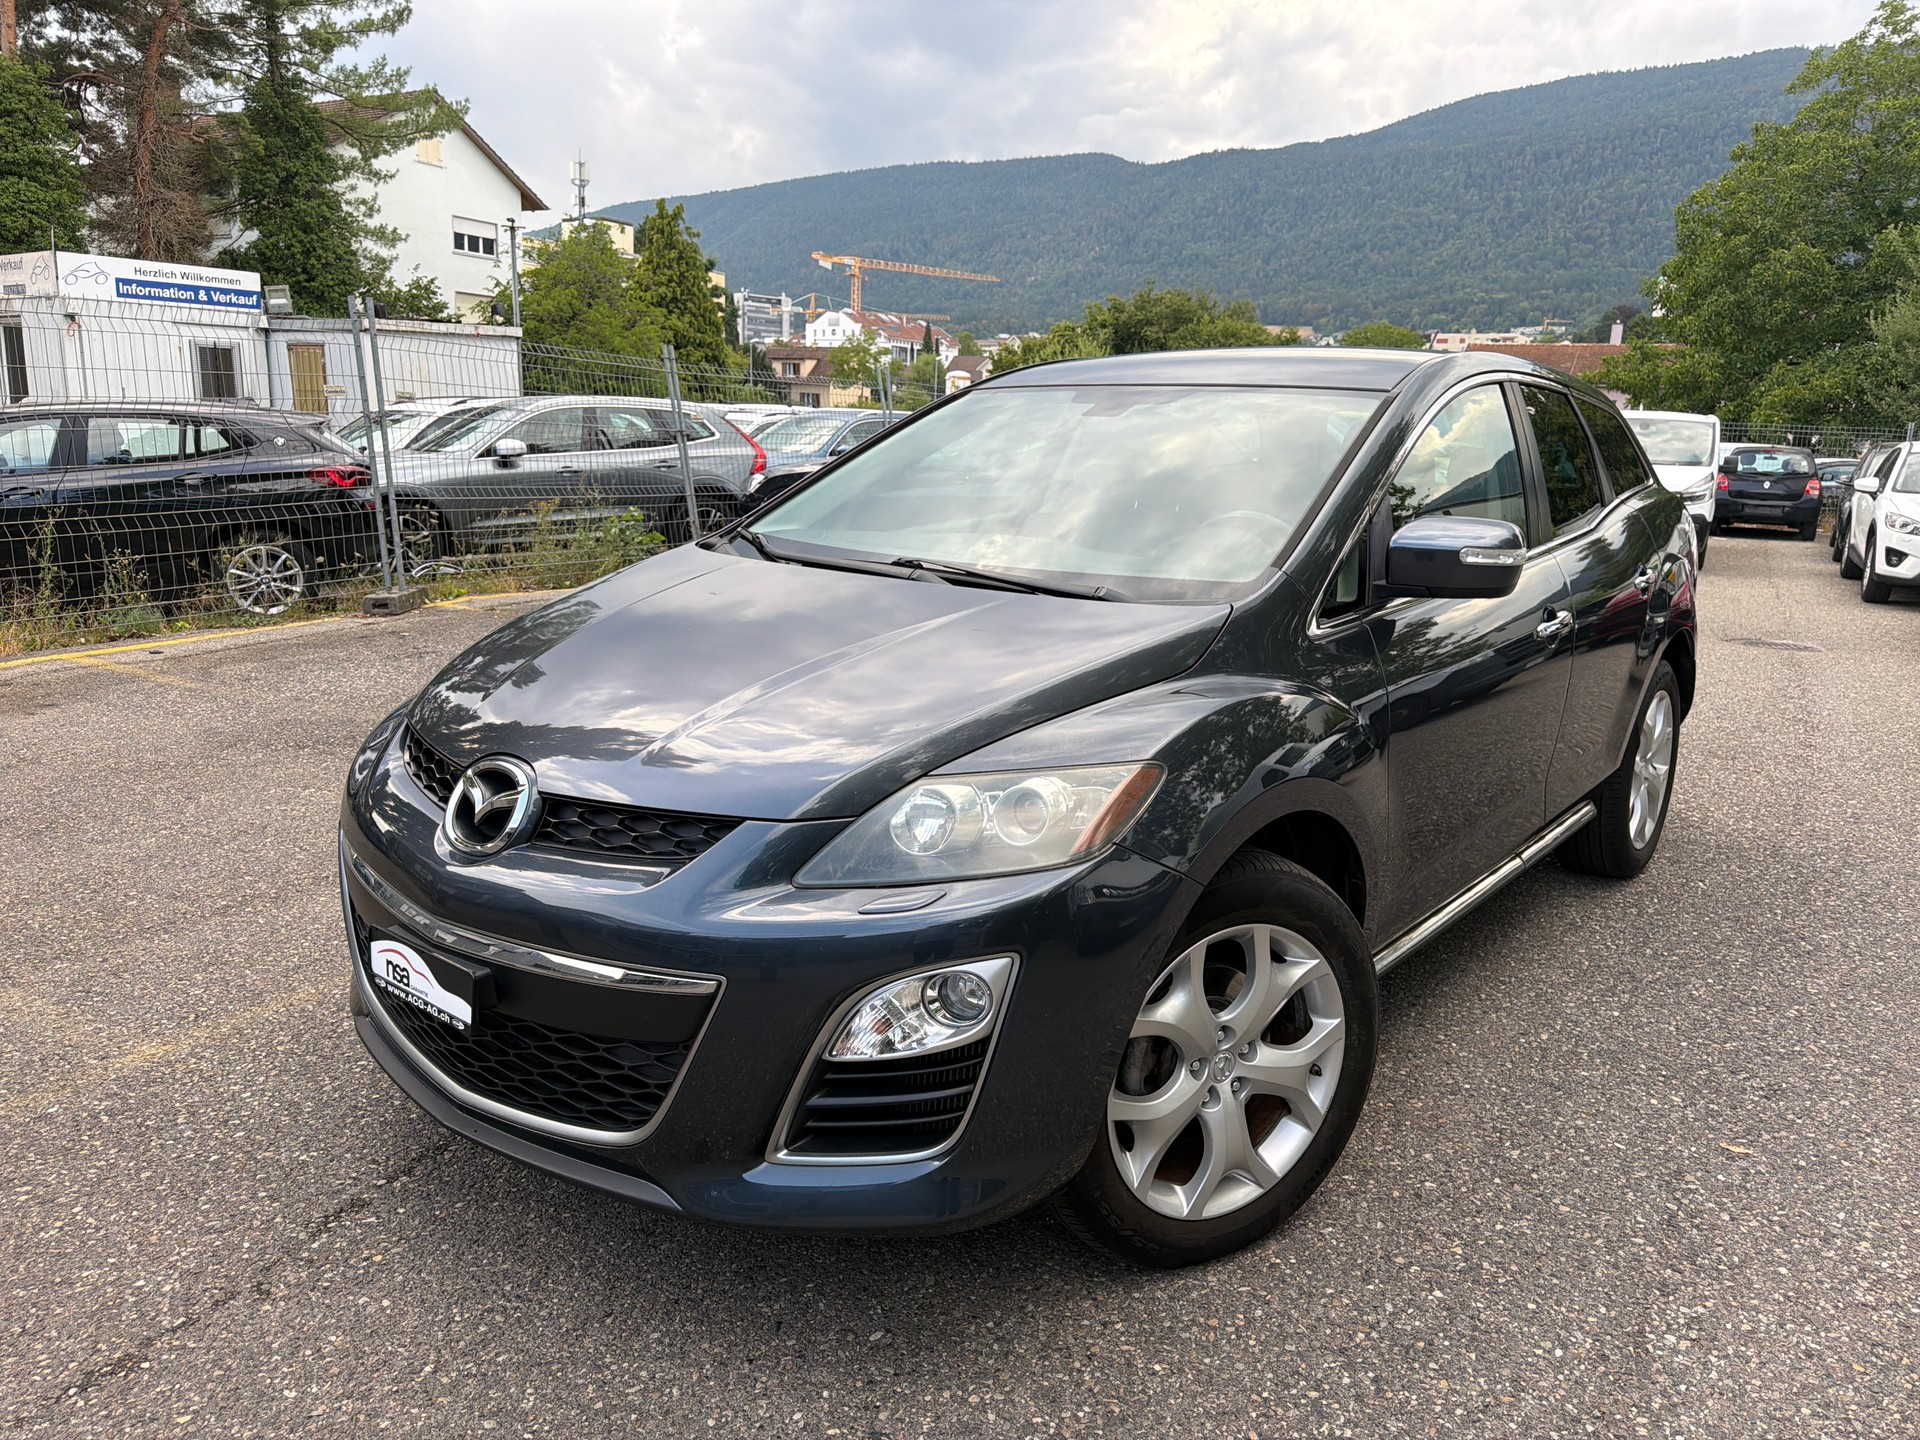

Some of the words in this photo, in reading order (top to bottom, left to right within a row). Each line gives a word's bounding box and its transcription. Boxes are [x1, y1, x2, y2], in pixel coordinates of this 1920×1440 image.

[134, 266, 177, 279] Herzlich
[180, 271, 241, 286] Willkommen
[119, 282, 195, 300] Information
[198, 289, 208, 302] &
[212, 292, 257, 306] Verkauf
[386, 958, 410, 988] nsa
[387, 984, 450, 1023] www.ACG-AG.ch
